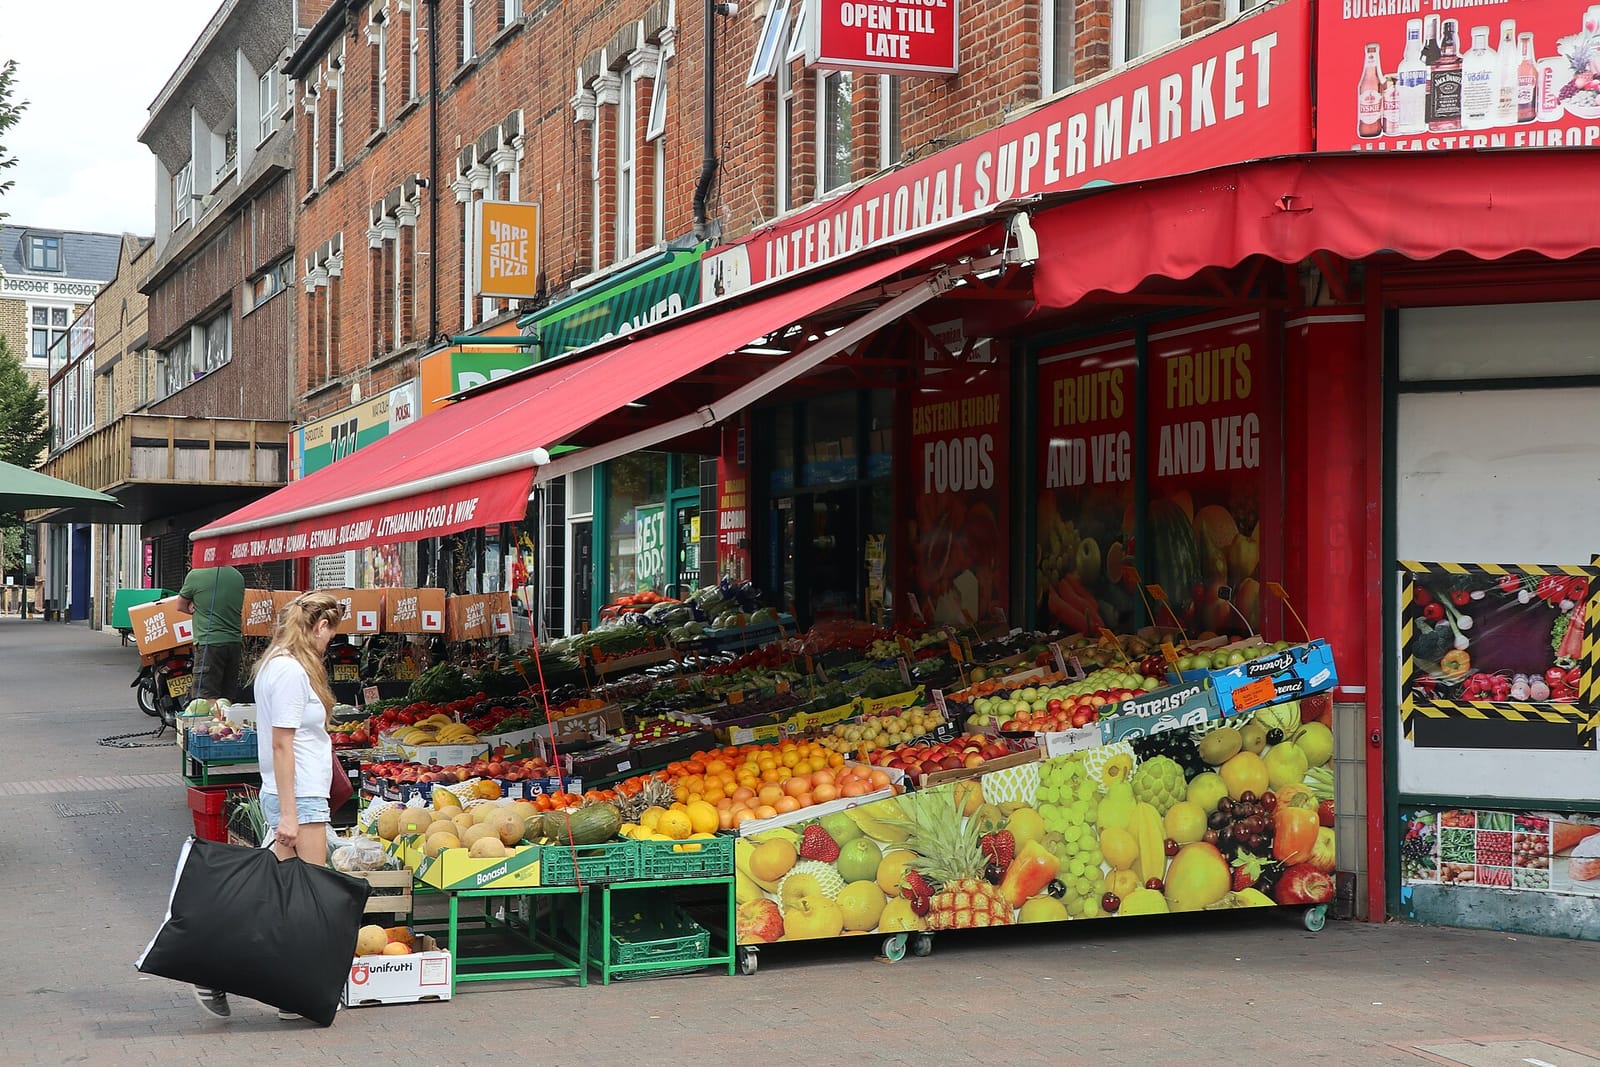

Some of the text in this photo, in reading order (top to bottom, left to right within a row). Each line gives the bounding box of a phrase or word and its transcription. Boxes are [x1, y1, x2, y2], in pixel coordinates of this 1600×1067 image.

[840, 3, 935, 34] OPEN TILL
[1343, 0, 1420, 20] BULGARIAN
[866, 32, 910, 59] LATE
[764, 32, 1279, 279] INTERNATIONAL SUPERMARKET
[489, 219, 528, 244] YARD
[489, 239, 528, 264] SALE
[489, 256, 528, 279] PIZZA
[1166, 343, 1252, 409] FRUITS
[1053, 368, 1124, 426] FRUITS
[912, 399, 960, 435] EASTERN
[1157, 412, 1261, 477] AND VEG
[924, 432, 995, 494] FOODS
[1046, 430, 1131, 488] AND VEG
[309, 527, 338, 549] ESTONIAN
[338, 519, 371, 544] BULGARIAN
[376, 509, 426, 537] LITHUANIAN
[424, 504, 446, 528] FOOD
[446, 503, 455, 526] &
[454, 497, 479, 523] WINE
[636, 511, 664, 553] BEST
[251, 600, 273, 609] YARD
[396, 597, 418, 607] YARD
[396, 604, 418, 615] SALE
[465, 602, 485, 615] YARD
[143, 612, 165, 627] YARD
[246, 615, 272, 627] PIZZA
[361, 615, 372, 626] L
[392, 612, 418, 624] PIZZA
[426, 615, 437, 626] L
[464, 618, 487, 631] PIZZA
[466, 610, 486, 622] SALE
[496, 618, 506, 629] L
[144, 626, 169, 645] PIZZA
[145, 619, 167, 635] SALE
[179, 626, 191, 638] L
[168, 674, 193, 689] KU20
[477, 862, 508, 886] Bonasol
[369, 962, 413, 974] unifrutti
